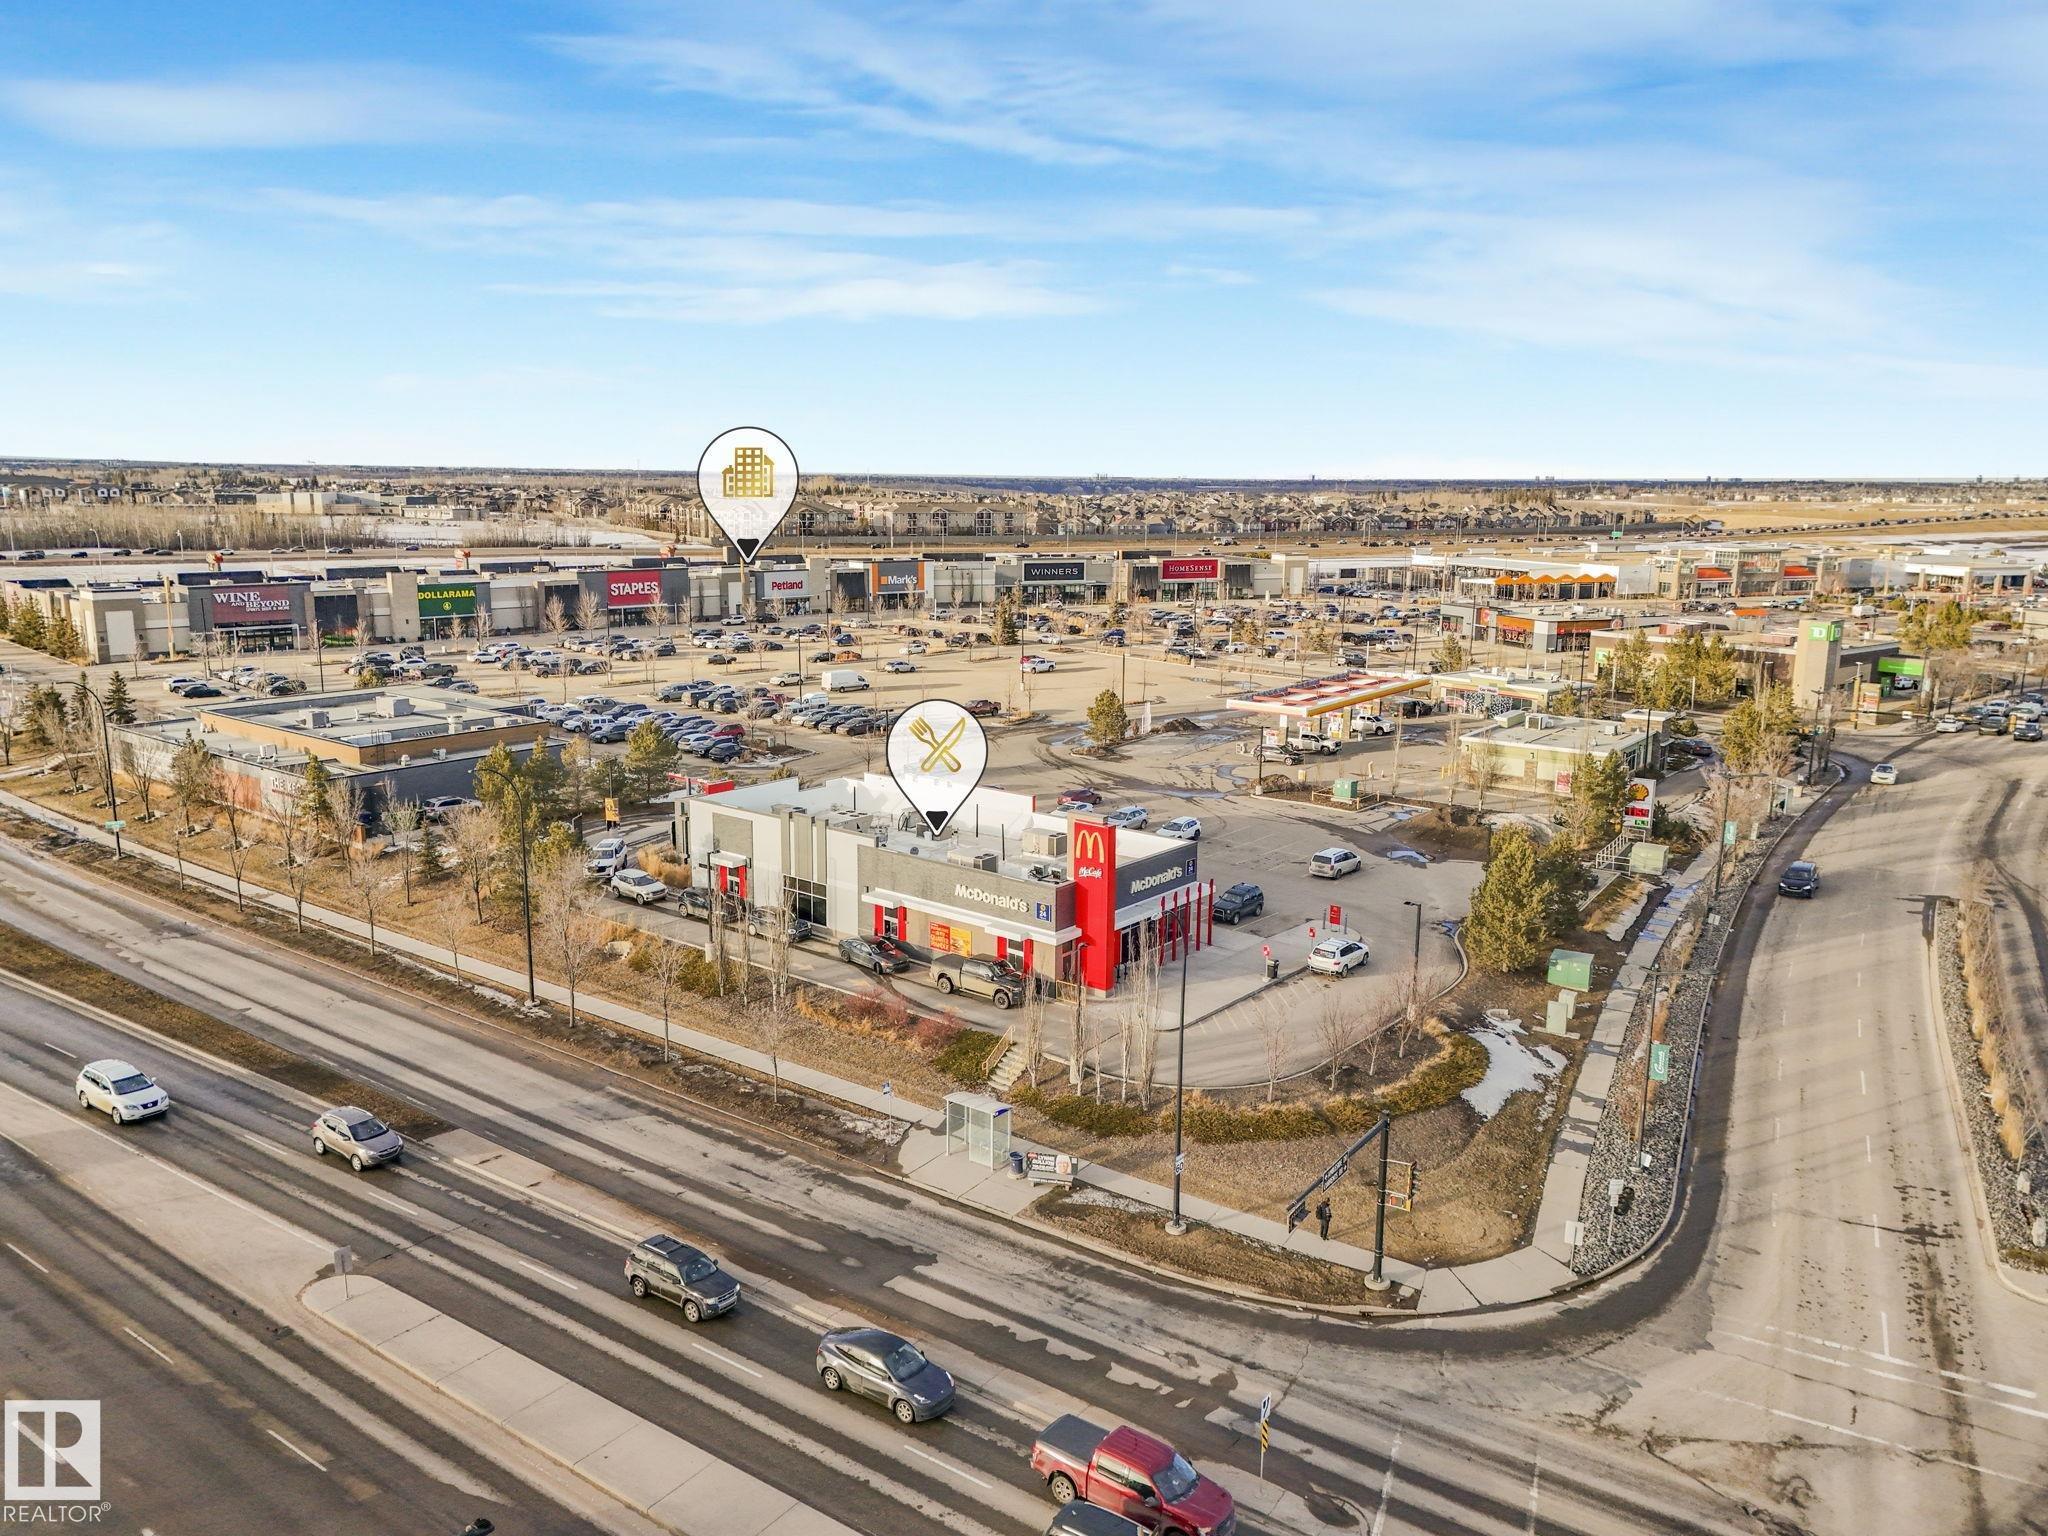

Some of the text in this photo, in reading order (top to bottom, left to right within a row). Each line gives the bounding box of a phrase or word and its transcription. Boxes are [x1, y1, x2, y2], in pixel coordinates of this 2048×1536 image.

[1030, 567, 1079, 576] WINNERS
[887, 574, 918, 585] Mark's
[610, 581, 660, 596] STAPLES
[771, 580, 803, 591] Petland
[213, 592, 260, 604] WINE
[417, 589, 476, 600] DOLLARAMA
[246, 600, 289, 608] BEYOND
[270, 777, 286, 790] THE
[1130, 866, 1183, 894] McDonald's
[954, 883, 1030, 913] McDonald's
[1039, 910, 1047, 918] 24
